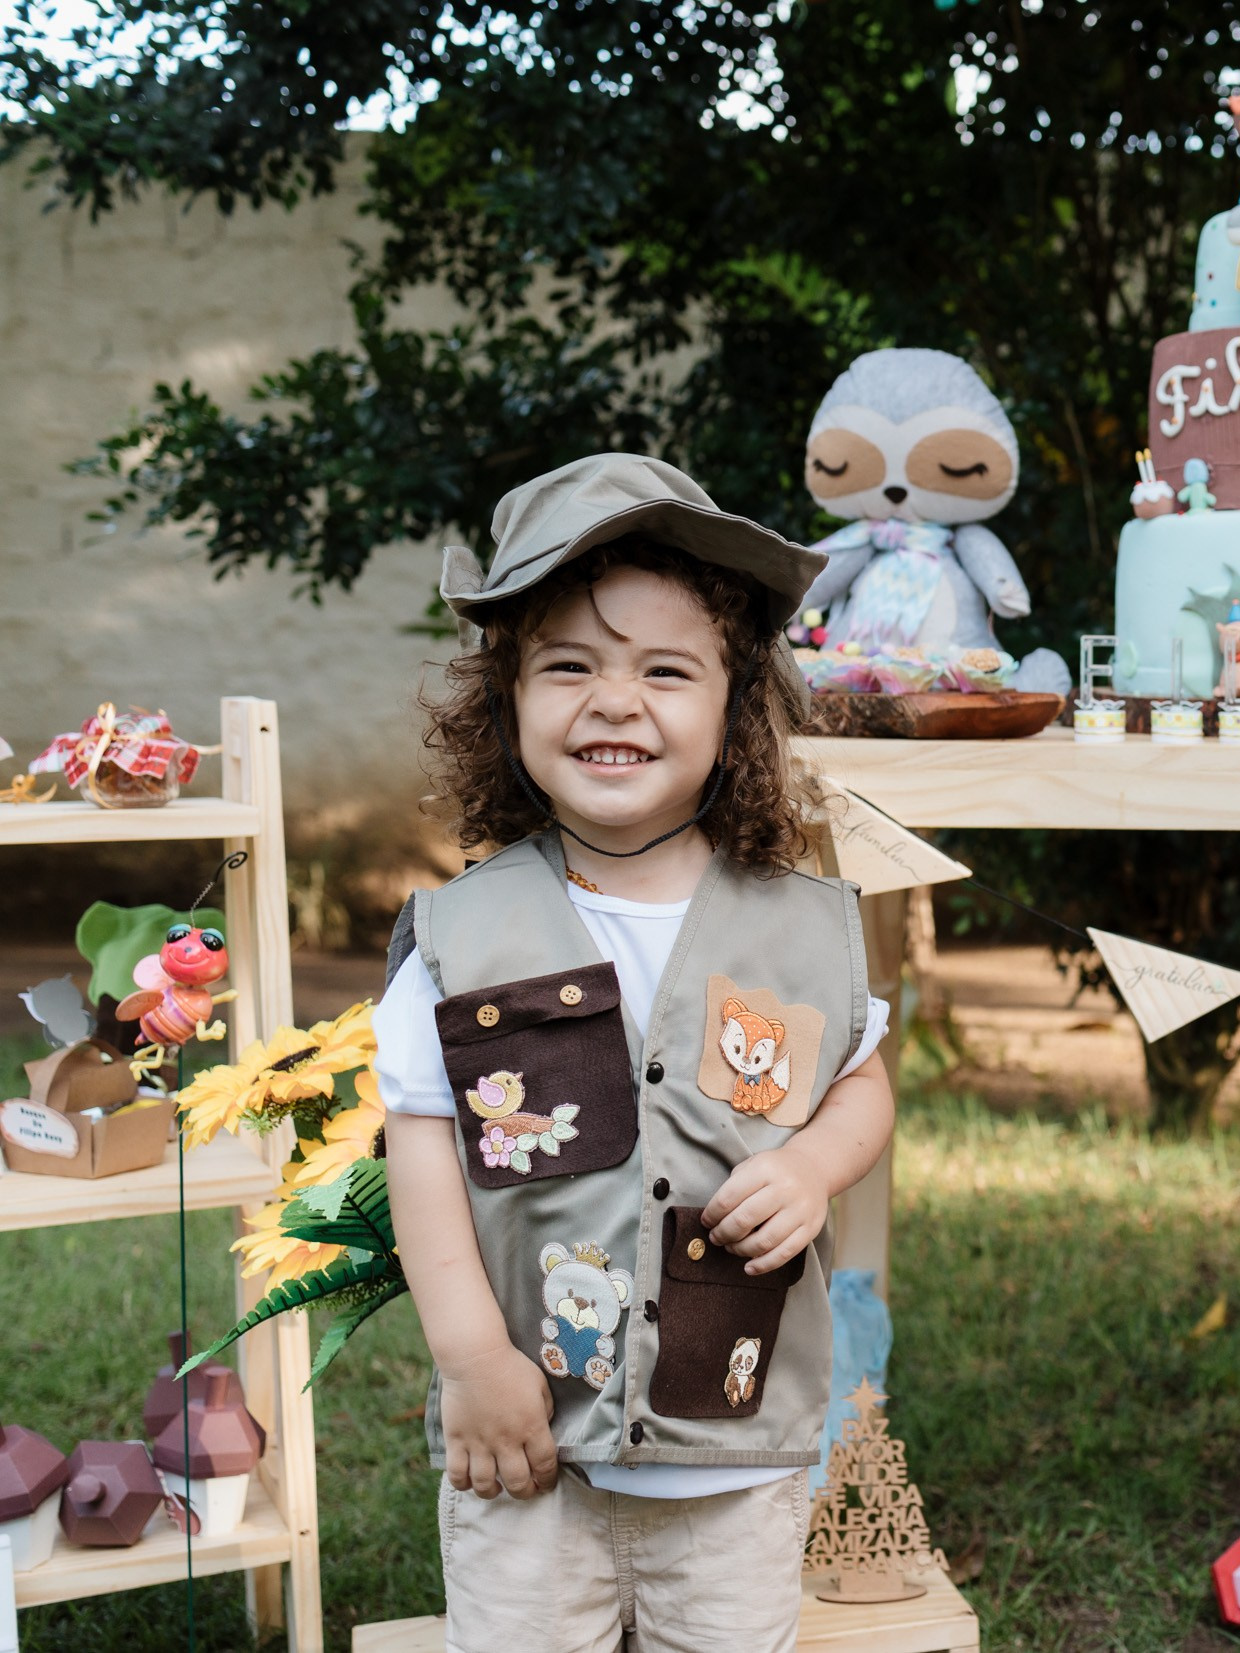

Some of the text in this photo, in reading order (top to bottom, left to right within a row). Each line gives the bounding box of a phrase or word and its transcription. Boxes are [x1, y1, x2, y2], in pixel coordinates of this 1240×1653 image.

[841, 1418, 890, 1441] PAZ
[828, 1439, 905, 1463] AMOR
[859, 1484, 924, 1508] VIDA
[814, 1507, 926, 1531] ALEGRIA
[810, 1528, 931, 1554] AMIZADE
[802, 1548, 950, 1575] SPERANÇA
